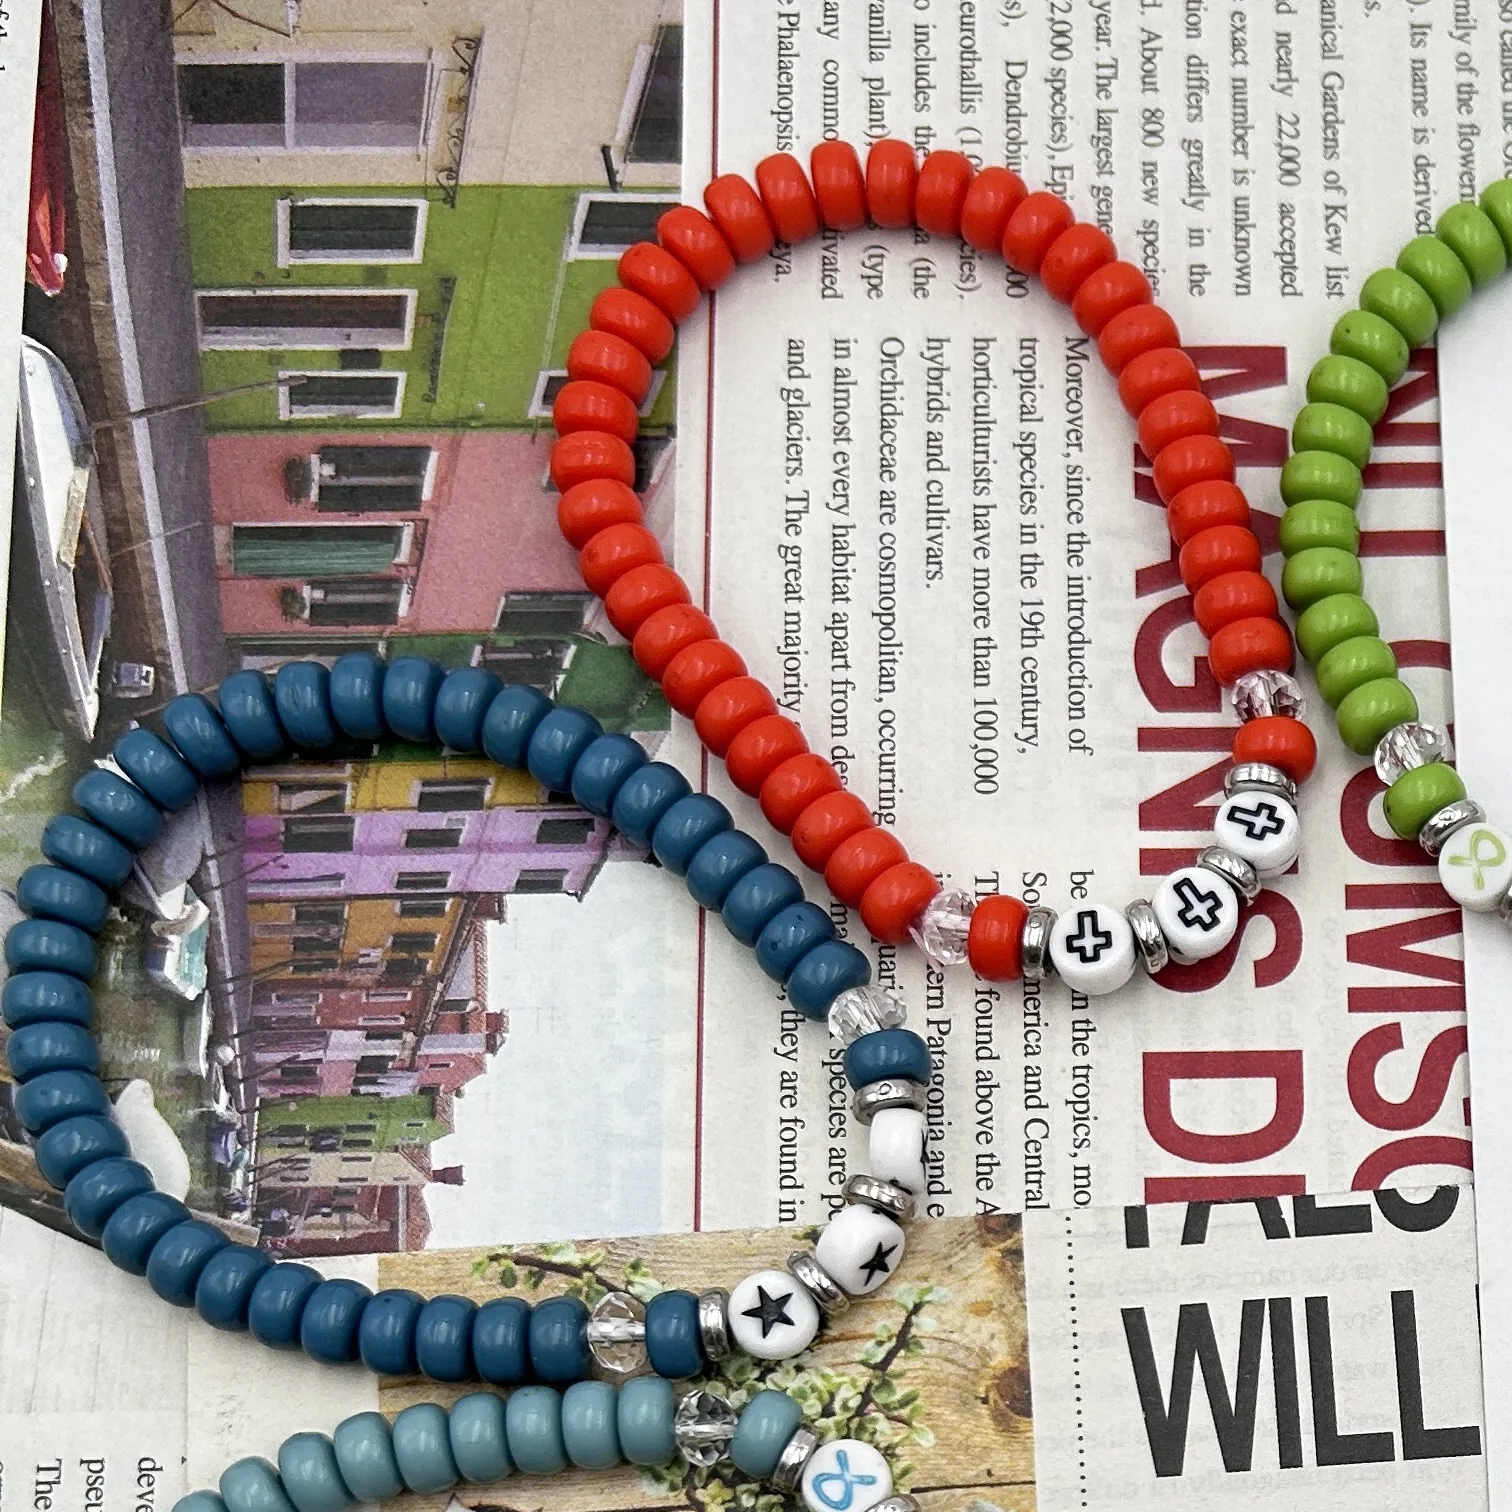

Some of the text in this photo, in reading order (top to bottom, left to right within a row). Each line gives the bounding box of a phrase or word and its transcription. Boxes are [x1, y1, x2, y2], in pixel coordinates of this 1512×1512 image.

[914, 24, 936, 112] includes
[1140, 28, 1165, 206] About 800 new
[1181, 54, 1210, 211] differs greatly
[1410, 24, 1432, 117] Its name
[1231, 78, 1256, 297] number unknown
[1269, 32, 1303, 297] nearly 22,000 accepted
[1321, 71, 1349, 299] Gardens Kew list
[871, 337, 905, 703] Orchidaceae are cosmopolitan,
[919, 337, 951, 588] hybrids and cultivars.
[1012, 338, 1045, 753] tropical species 19th century,
[1062, 337, 1093, 721] Moreover, since introduction
[969, 337, 999, 795] horticulturists have more than 100,000
[779, 1071, 805, 1192] are found
[975, 988, 1001, 1145] found above
[1023, 1065, 1051, 1212] and Central
[1065, 1064, 1094, 1158] tropics,
[1121, 1290, 1482, 1477] WILL
[34, 1458, 62, 1511] The
